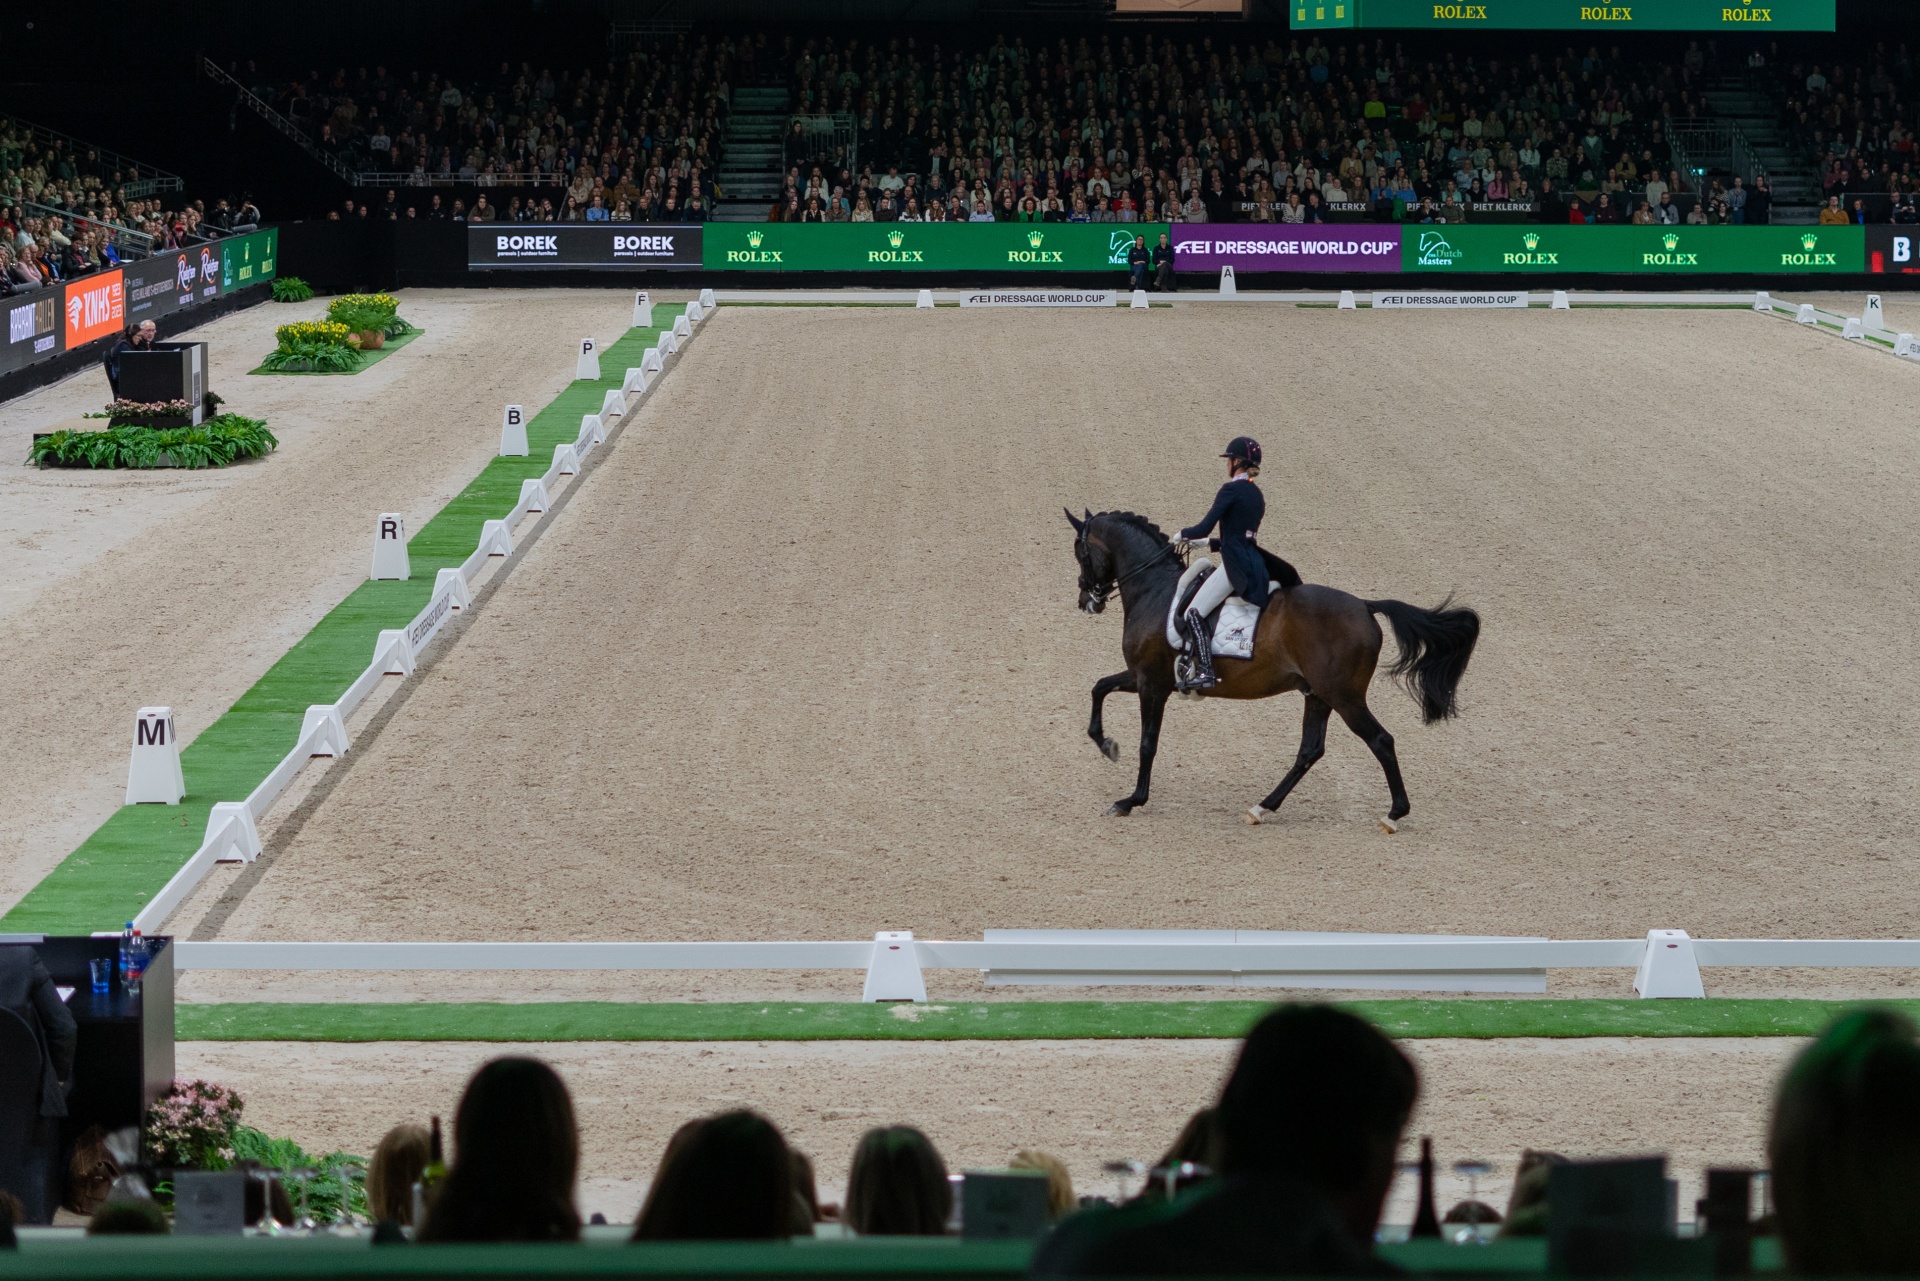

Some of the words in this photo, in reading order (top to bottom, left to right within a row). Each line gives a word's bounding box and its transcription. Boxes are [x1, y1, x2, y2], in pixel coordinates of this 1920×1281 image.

[1433, 5, 1487, 19] ROLEX
[1581, 7, 1632, 20] ROLEX
[1722, 8, 1772, 22] ROLEX
[1330, 202, 1366, 211] KLERKX
[1473, 203, 1494, 211] PIET
[1495, 203, 1532, 211] KLERKX
[497, 236, 558, 250] BOREK
[614, 236, 674, 250] BOREK
[1174, 240, 1211, 254] FEI
[1215, 240, 1299, 255] DRESSAGE
[1300, 240, 1358, 255] WORLD
[1893, 236, 1920, 262] B
[727, 250, 783, 263] ROLEX
[868, 251, 923, 263] ROLEX
[1008, 251, 1063, 263] ROLEX
[1436, 249, 1463, 258] Dutch
[1503, 253, 1558, 264] ROLEX
[1643, 253, 1698, 265] ROLEX
[1781, 253, 1836, 265] ROLEX
[1418, 257, 1452, 266] Masters
[1223, 269, 1232, 278] A
[638, 295, 646, 305] F
[969, 295, 991, 303] FEI
[994, 294, 1046, 303] DRESSAGE
[1047, 294, 1083, 303] WORLD
[1381, 296, 1403, 304] FEI
[1406, 296, 1458, 304] DRESSAGE
[1459, 296, 1495, 304] WORLD
[1870, 298, 1879, 309] K
[83, 285, 111, 328] KNHS
[583, 342, 593, 355] P
[508, 410, 521, 425] B
[381, 520, 397, 540] R
[137, 718, 165, 746] M
